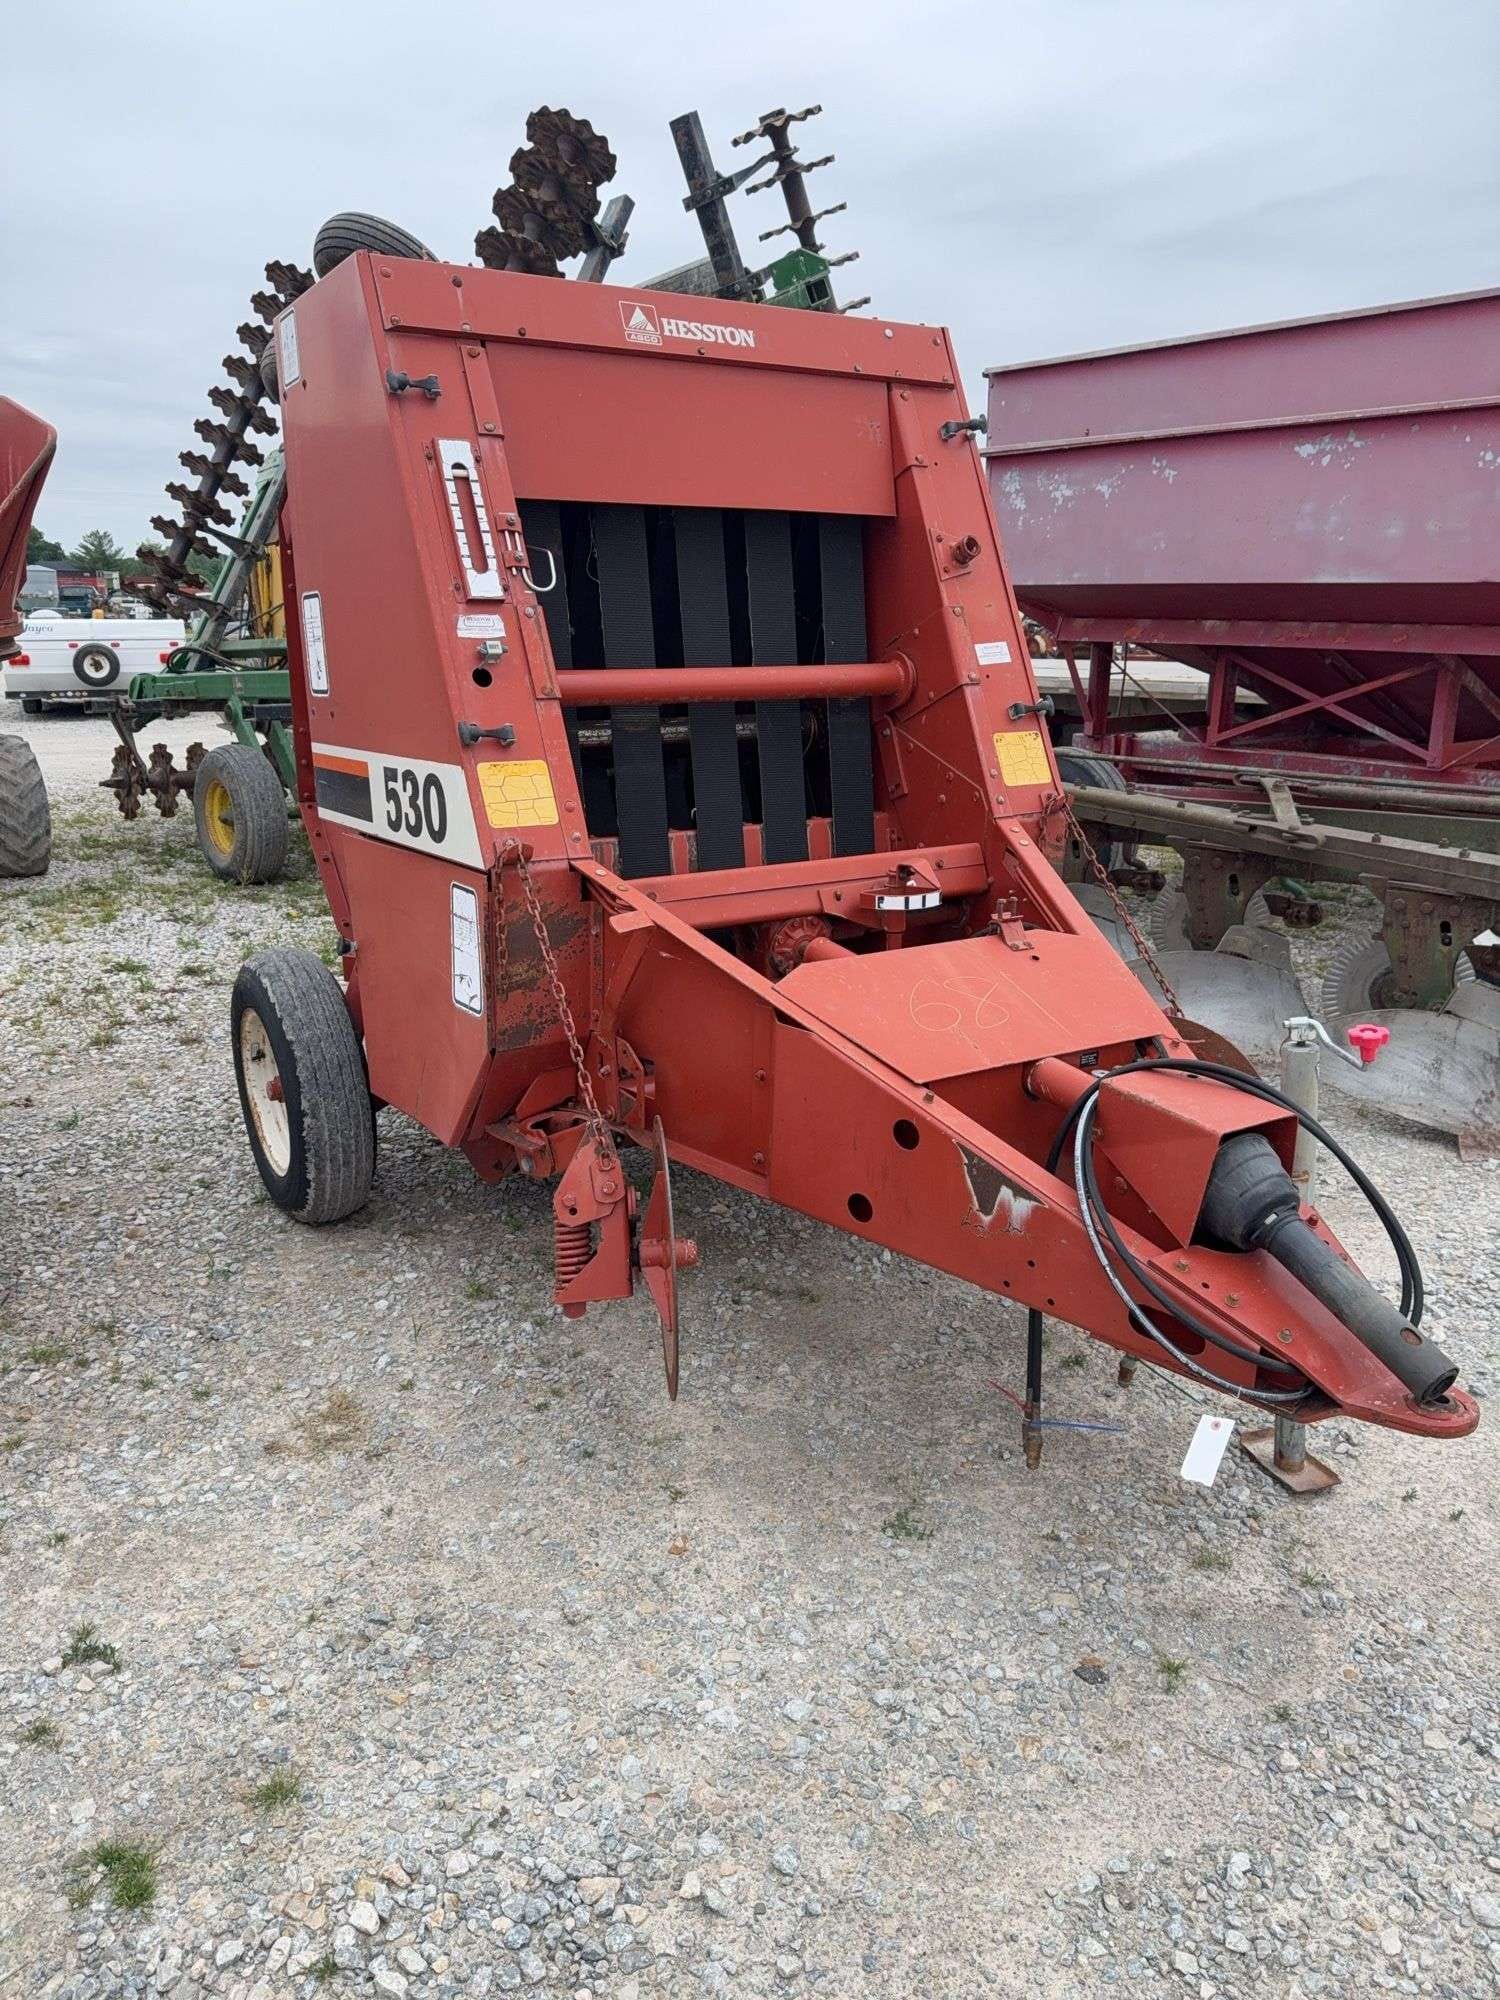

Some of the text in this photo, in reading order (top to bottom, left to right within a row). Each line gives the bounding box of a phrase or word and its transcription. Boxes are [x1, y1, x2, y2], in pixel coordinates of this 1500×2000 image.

[630, 333, 659, 343] AGCO
[661, 317, 755, 347] HESSTON
[384, 767, 447, 844] 530
